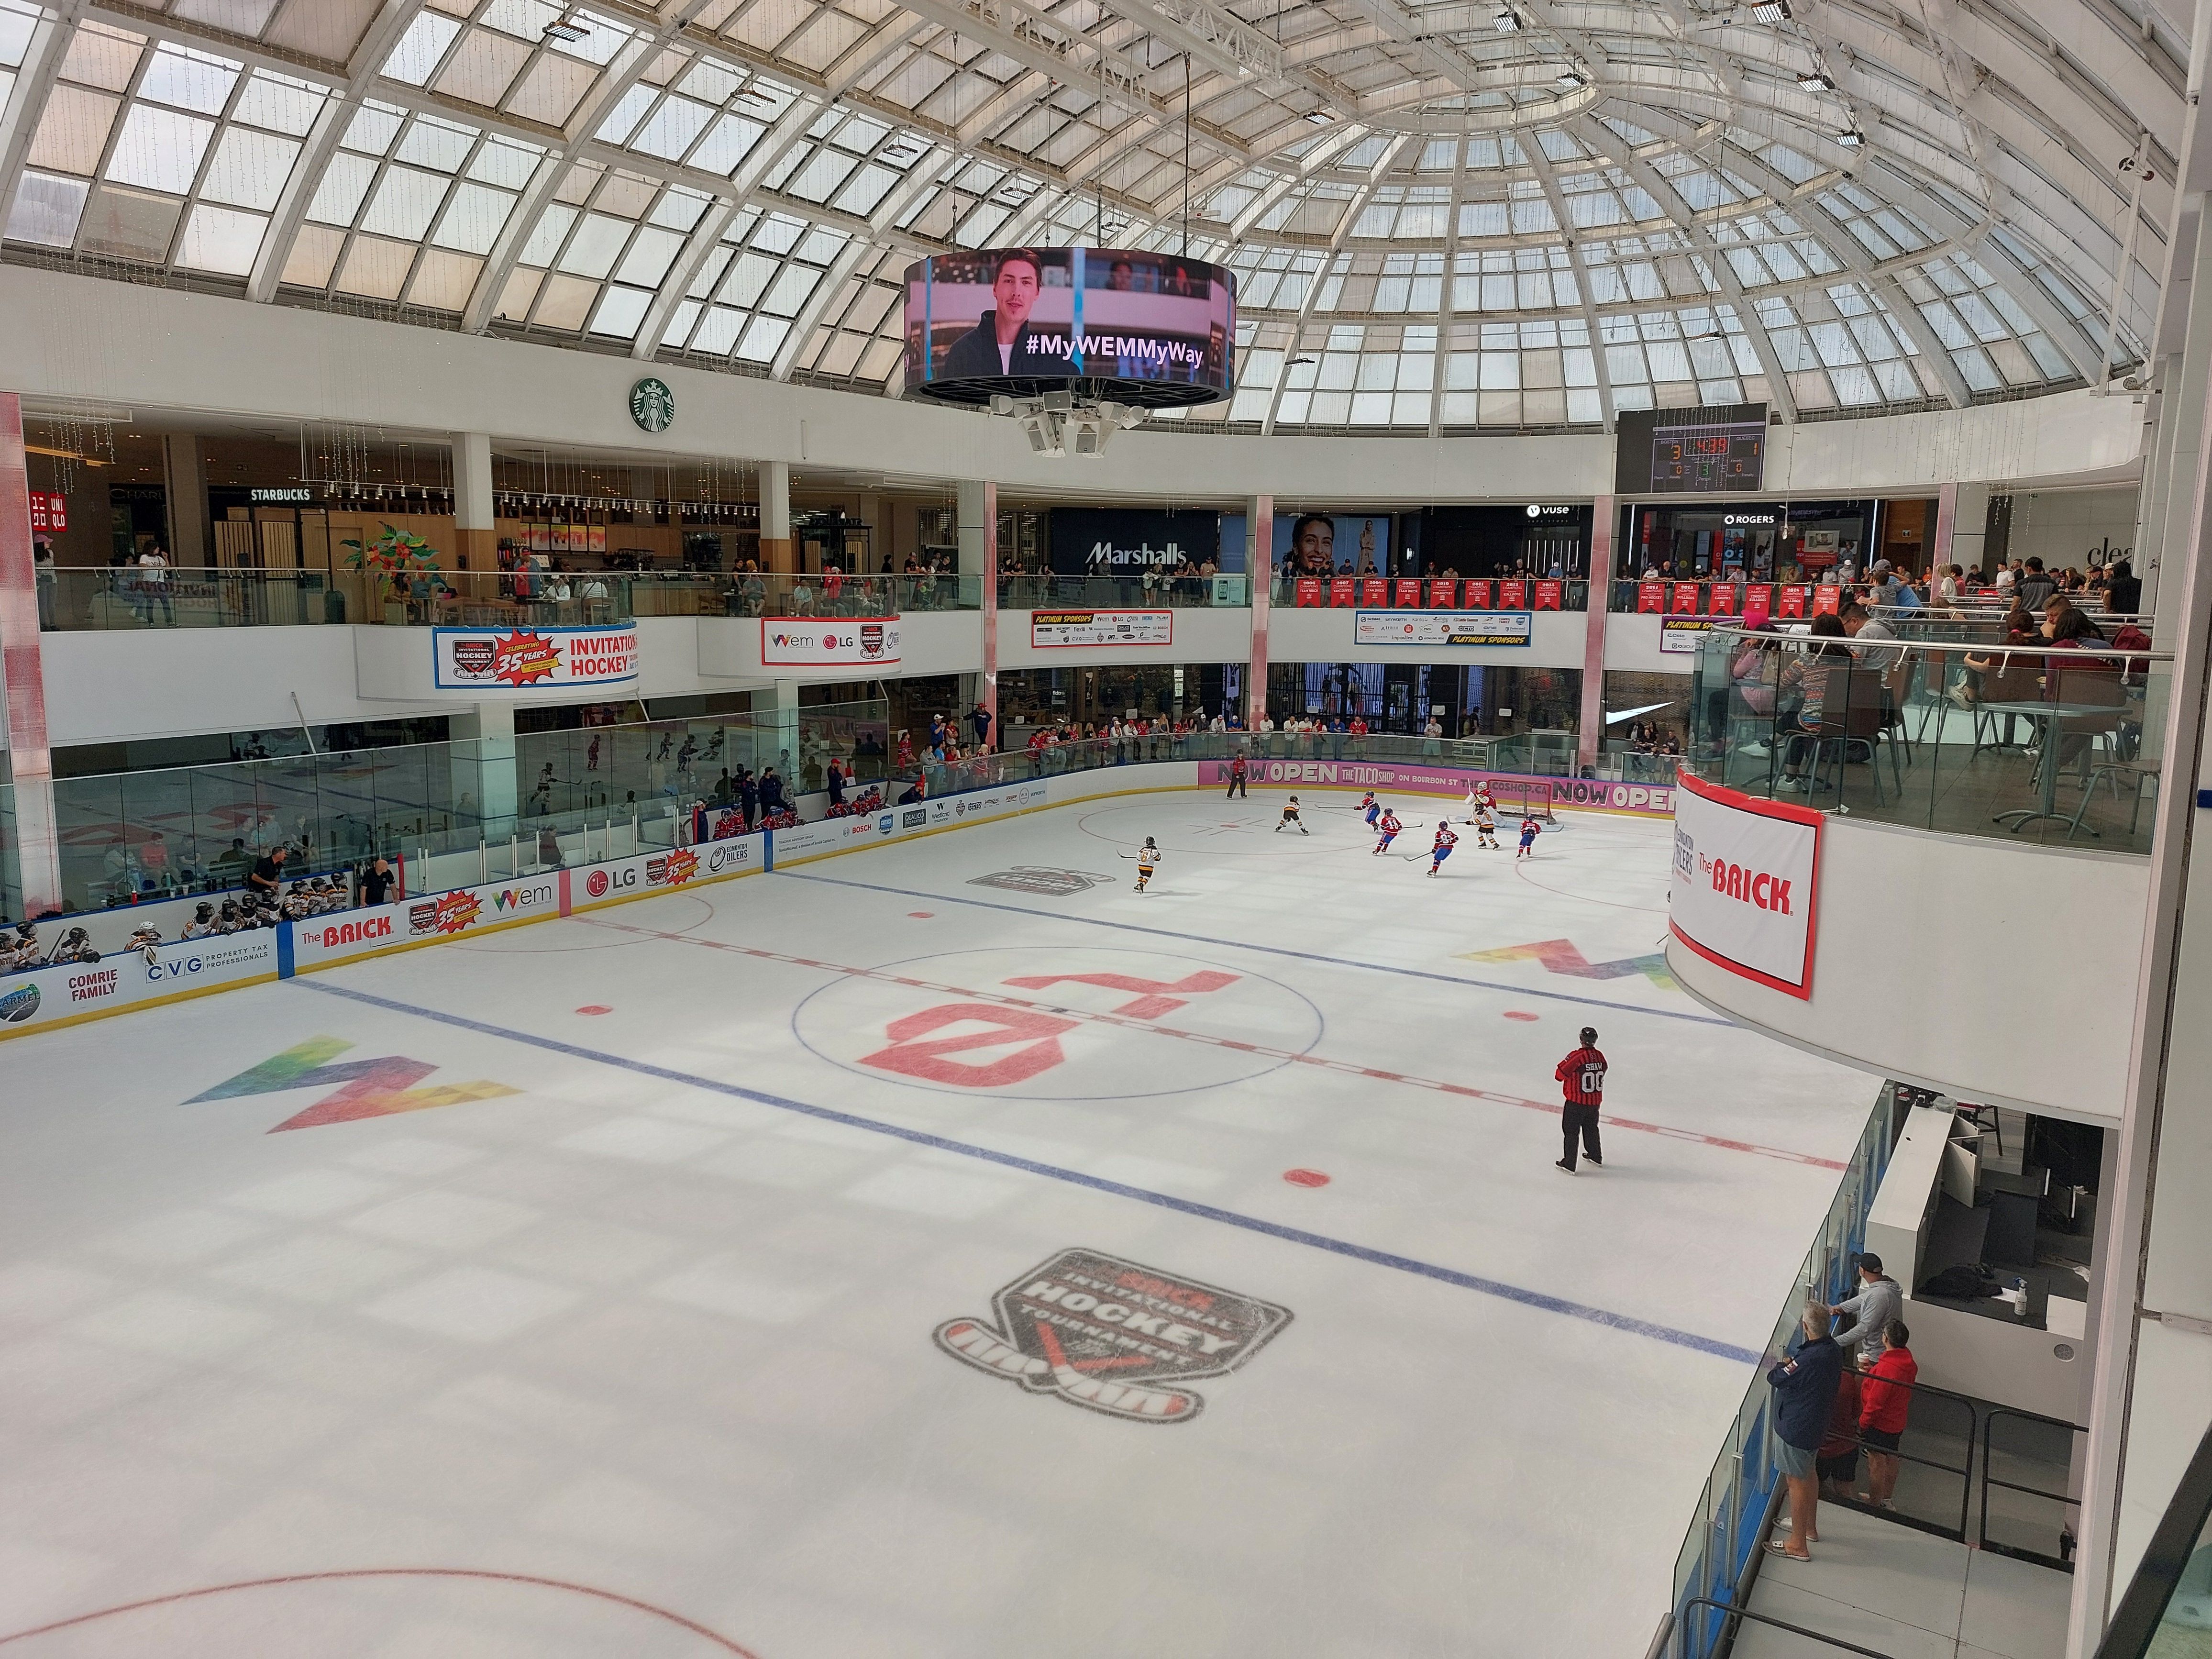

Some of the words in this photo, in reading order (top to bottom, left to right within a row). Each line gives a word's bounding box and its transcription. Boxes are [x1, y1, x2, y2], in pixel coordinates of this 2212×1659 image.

[1026, 335, 1203, 369] #MyWEMMyWay
[1673, 445, 1681, 460] 3
[1754, 442, 1758, 455] 1
[1676, 465, 1681, 475] 0
[1703, 465, 1709, 476] 3
[1736, 464, 1742, 473] 0
[251, 489, 310, 500] STARBUCKS
[51, 498, 63, 511] UNI
[52, 513, 65, 529] QLO
[1085, 542, 1187, 565] Marshalls
[505, 641, 540, 653] CELEBRATING
[771, 634, 813, 647] Wem
[840, 637, 853, 647] LG
[498, 652, 523, 674] 35
[523, 649, 548, 661] YEARS
[571, 655, 628, 676] HOCKEY
[1218, 763, 1268, 782] NW
[1270, 763, 1338, 782] OPEN
[1342, 769, 1354, 780] THE
[1353, 767, 1378, 784] TACO
[1378, 770, 1394, 783] SHOP
[1412, 774, 1447, 785] BOURBON
[1449, 778, 1458, 786] ST
[1553, 781, 1610, 806] NOW
[906, 812, 924, 821] QUALICO
[932, 811, 950, 819] Westland
[852, 824, 872, 834] BOSCH
[727, 843, 747, 852] EDMONTON
[1678, 828, 1694, 851] EDMONTON
[727, 850, 748, 862] OILERS
[667, 863, 680, 878] 35
[679, 859, 692, 868] YEARS
[613, 868, 636, 889] LG
[1700, 852, 1712, 874] The
[1713, 858, 1792, 915] BRICK
[443, 897, 466, 909] CELEBRATING
[491, 885, 552, 913] Wem
[411, 911, 435, 921] HOCKEY
[439, 907, 455, 927] 35
[455, 902, 472, 913] YEARS
[302, 932, 321, 944] The
[324, 916, 392, 947] BRICK
[206, 948, 248, 961] PROPERTY
[252, 944, 268, 952] TAX
[207, 951, 268, 969] PROFESSIONALS
[148, 958, 202, 980] CVG
[69, 969, 118, 989] COMRIE
[0, 993, 40, 1006] ARMEL
[72, 982, 116, 1002] FAMILY
[1585, 1062, 1603, 1071] SHAW
[1582, 1071, 1604, 1093] 00
[1063, 1272, 1233, 1331] INVITATIONAL
[1021, 1281, 1238, 1355] HOCKEY
[1019, 1304, 1193, 1364] TOURNAMENT
